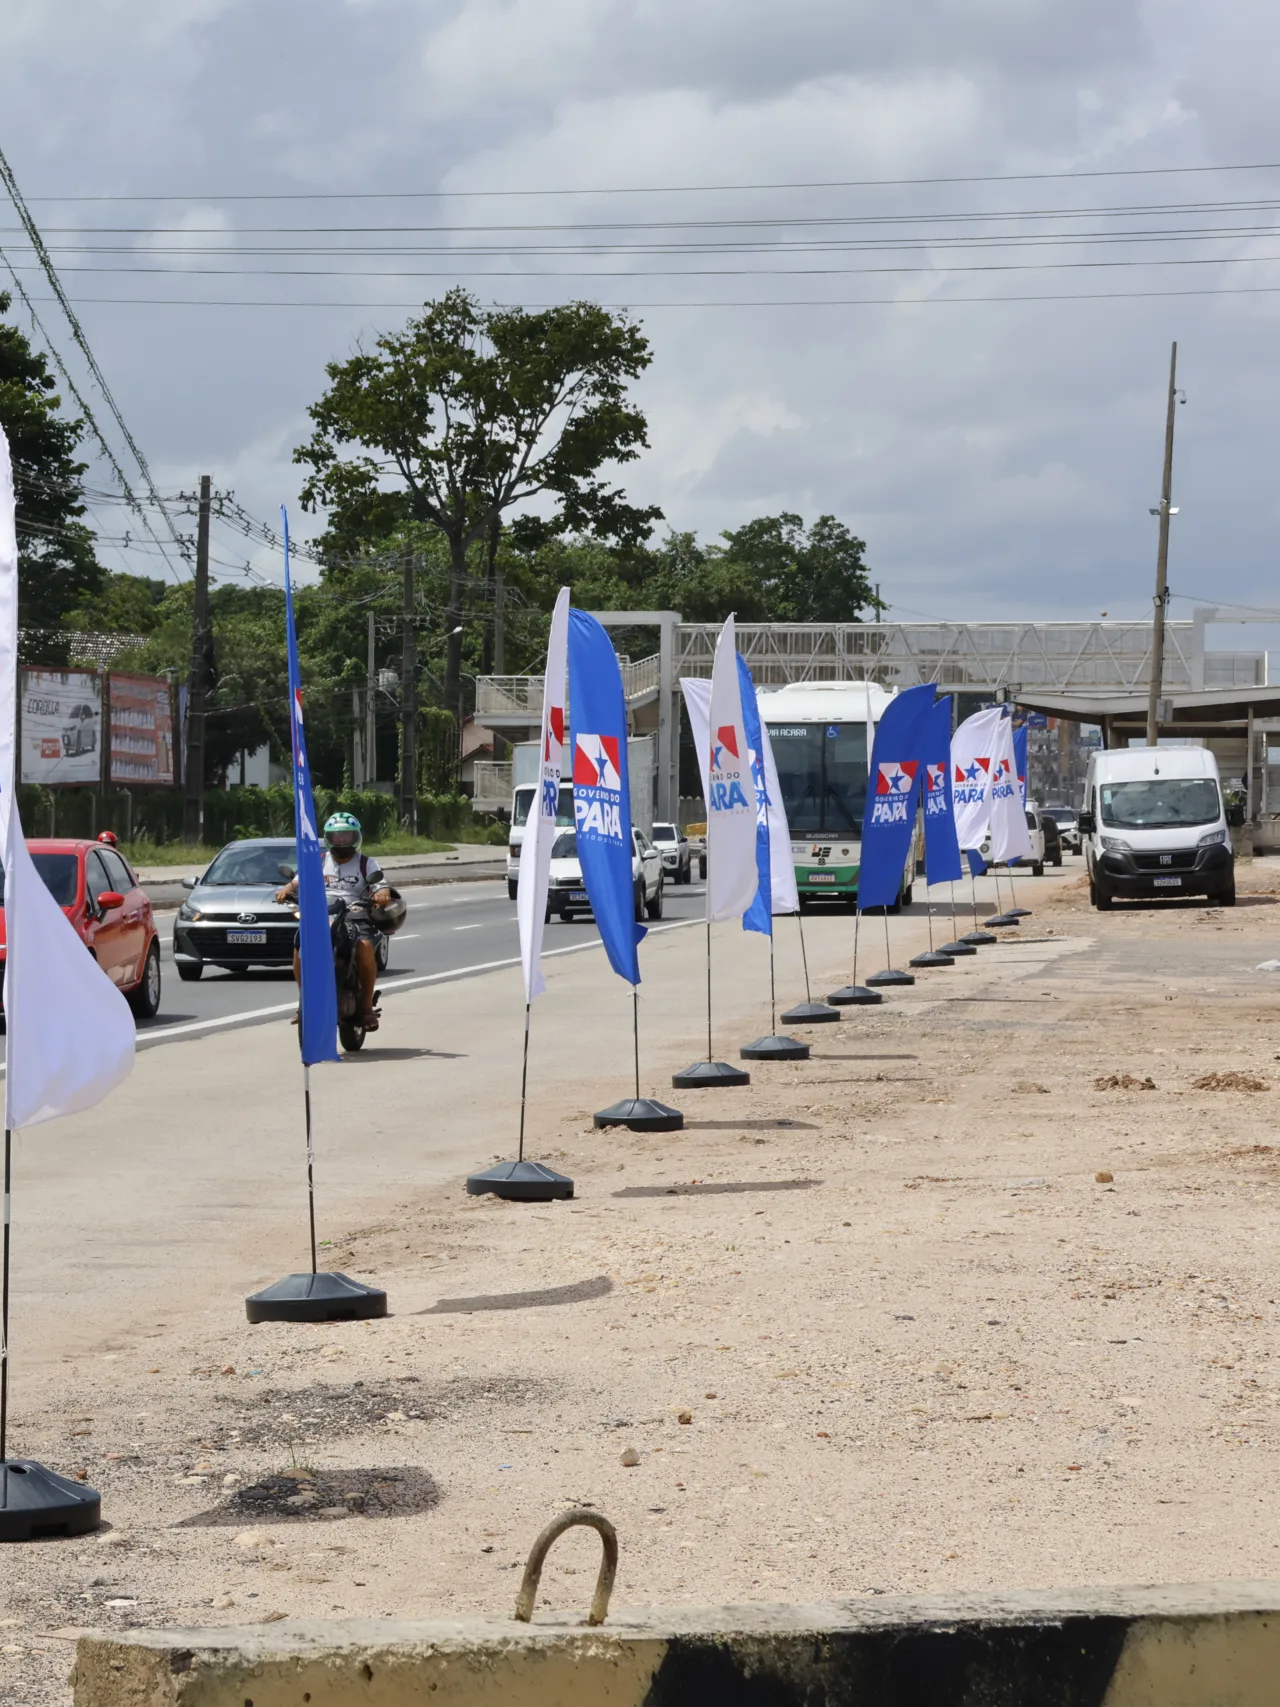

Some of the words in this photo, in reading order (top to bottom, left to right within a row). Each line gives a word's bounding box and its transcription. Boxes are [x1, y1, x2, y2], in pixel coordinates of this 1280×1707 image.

[26, 699, 61, 716] COROLLA
[727, 771, 740, 780] DO
[610, 793, 620, 803] DO
